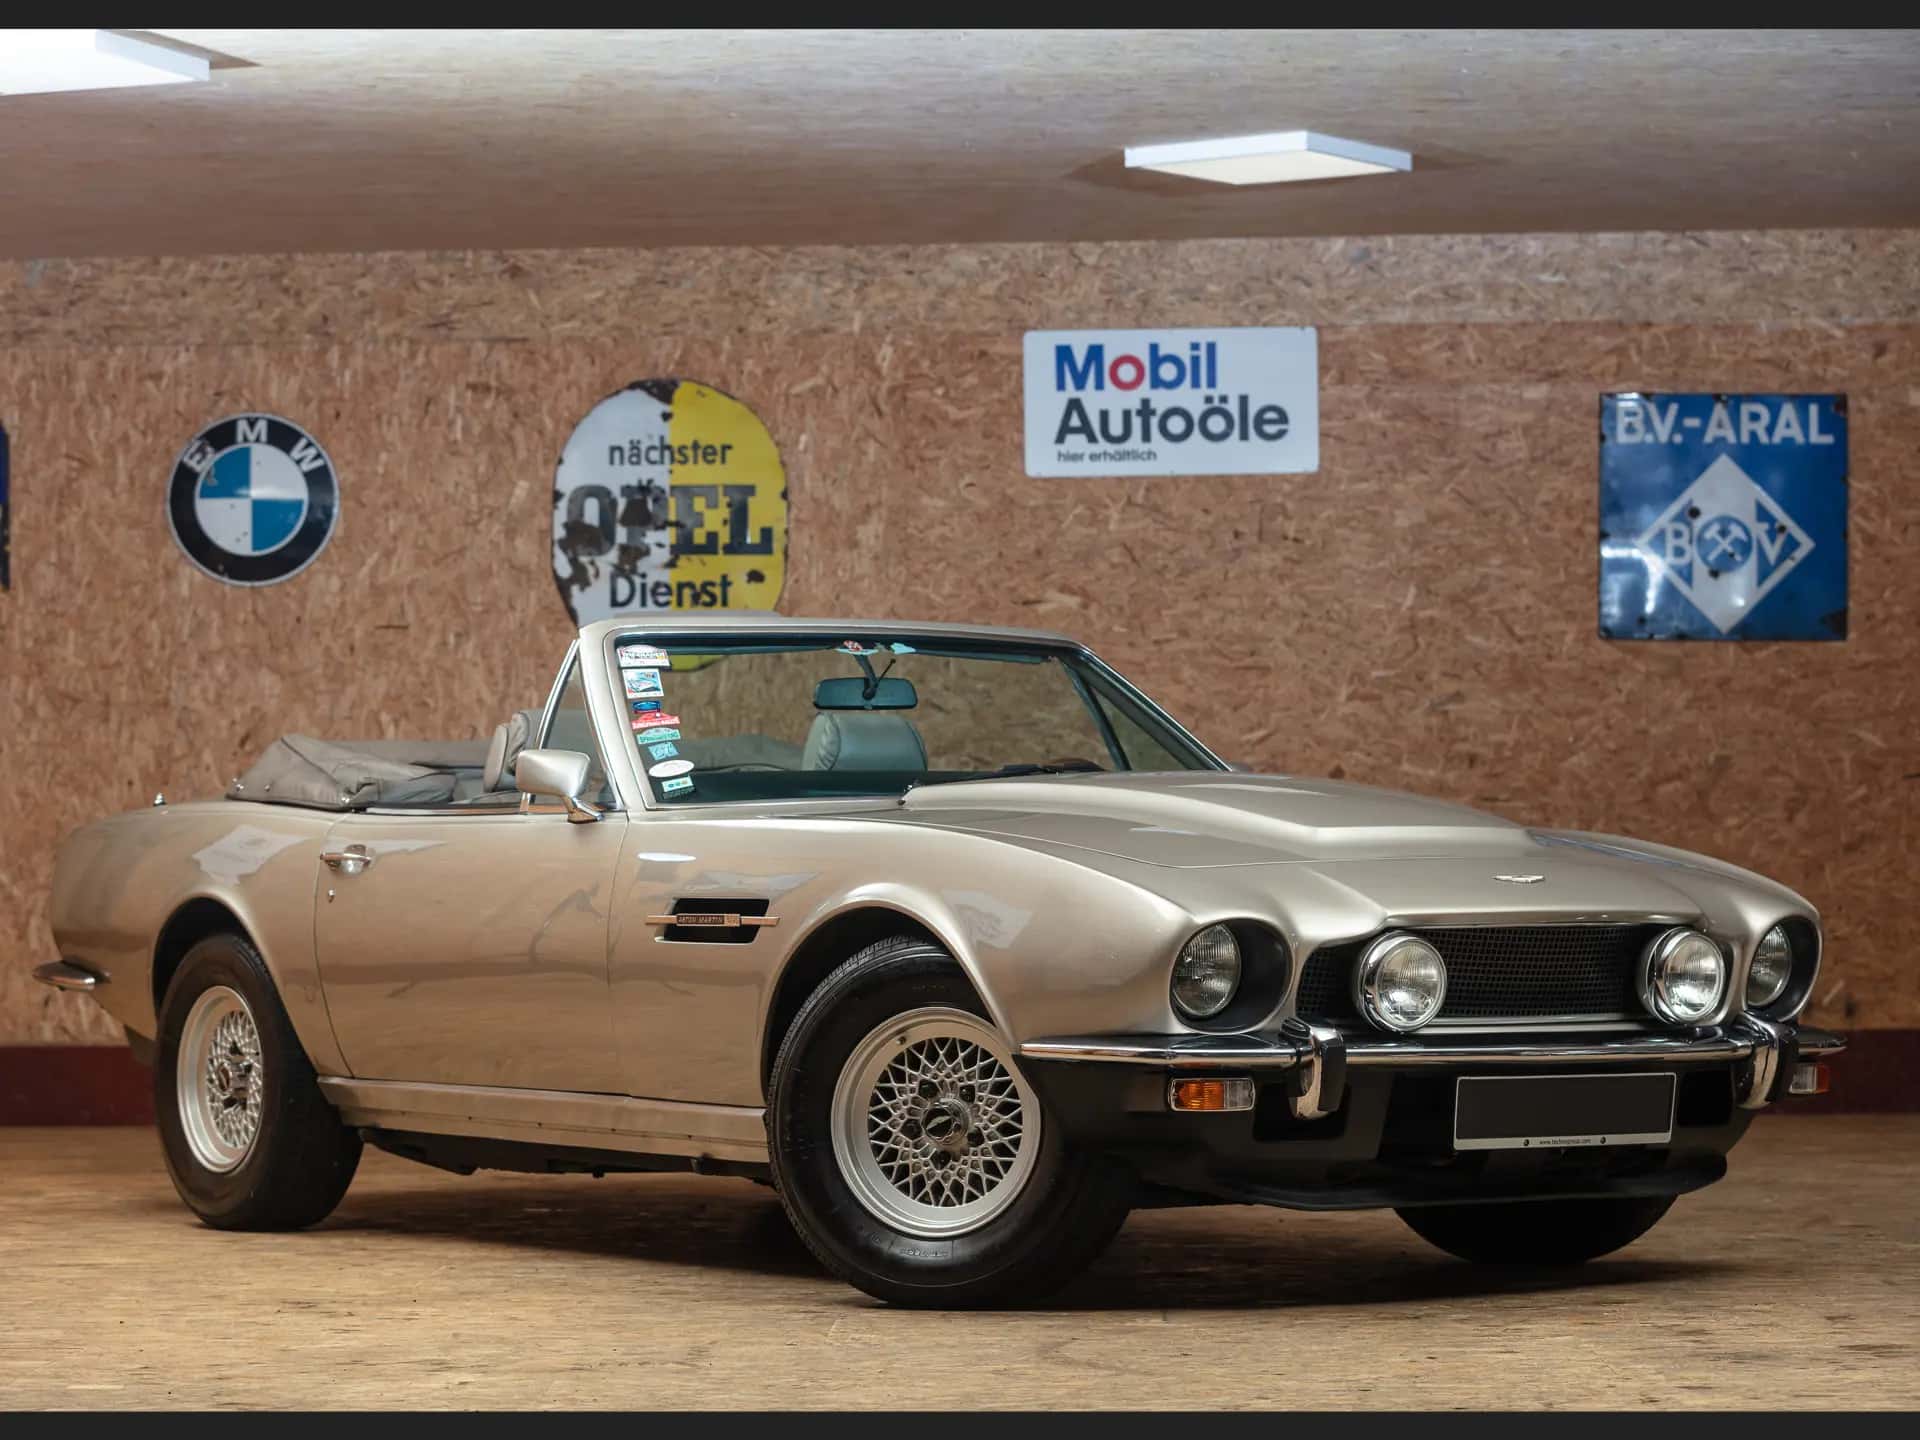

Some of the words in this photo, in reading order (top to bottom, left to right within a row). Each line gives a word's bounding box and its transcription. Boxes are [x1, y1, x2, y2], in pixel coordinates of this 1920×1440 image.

[1055, 341, 1217, 391] Mobil
[1054, 394, 1290, 445] Autoöle
[1616, 401, 1835, 444] B.V.-ARAL
[183, 418, 324, 473] BMW
[609, 436, 733, 466] nächster
[1057, 450, 1085, 463] hier
[1088, 448, 1158, 463] erhältlich
[567, 484, 773, 556] OPEL
[1665, 522, 1691, 566] B
[1757, 523, 1788, 566] V
[609, 571, 733, 608] Dienst
